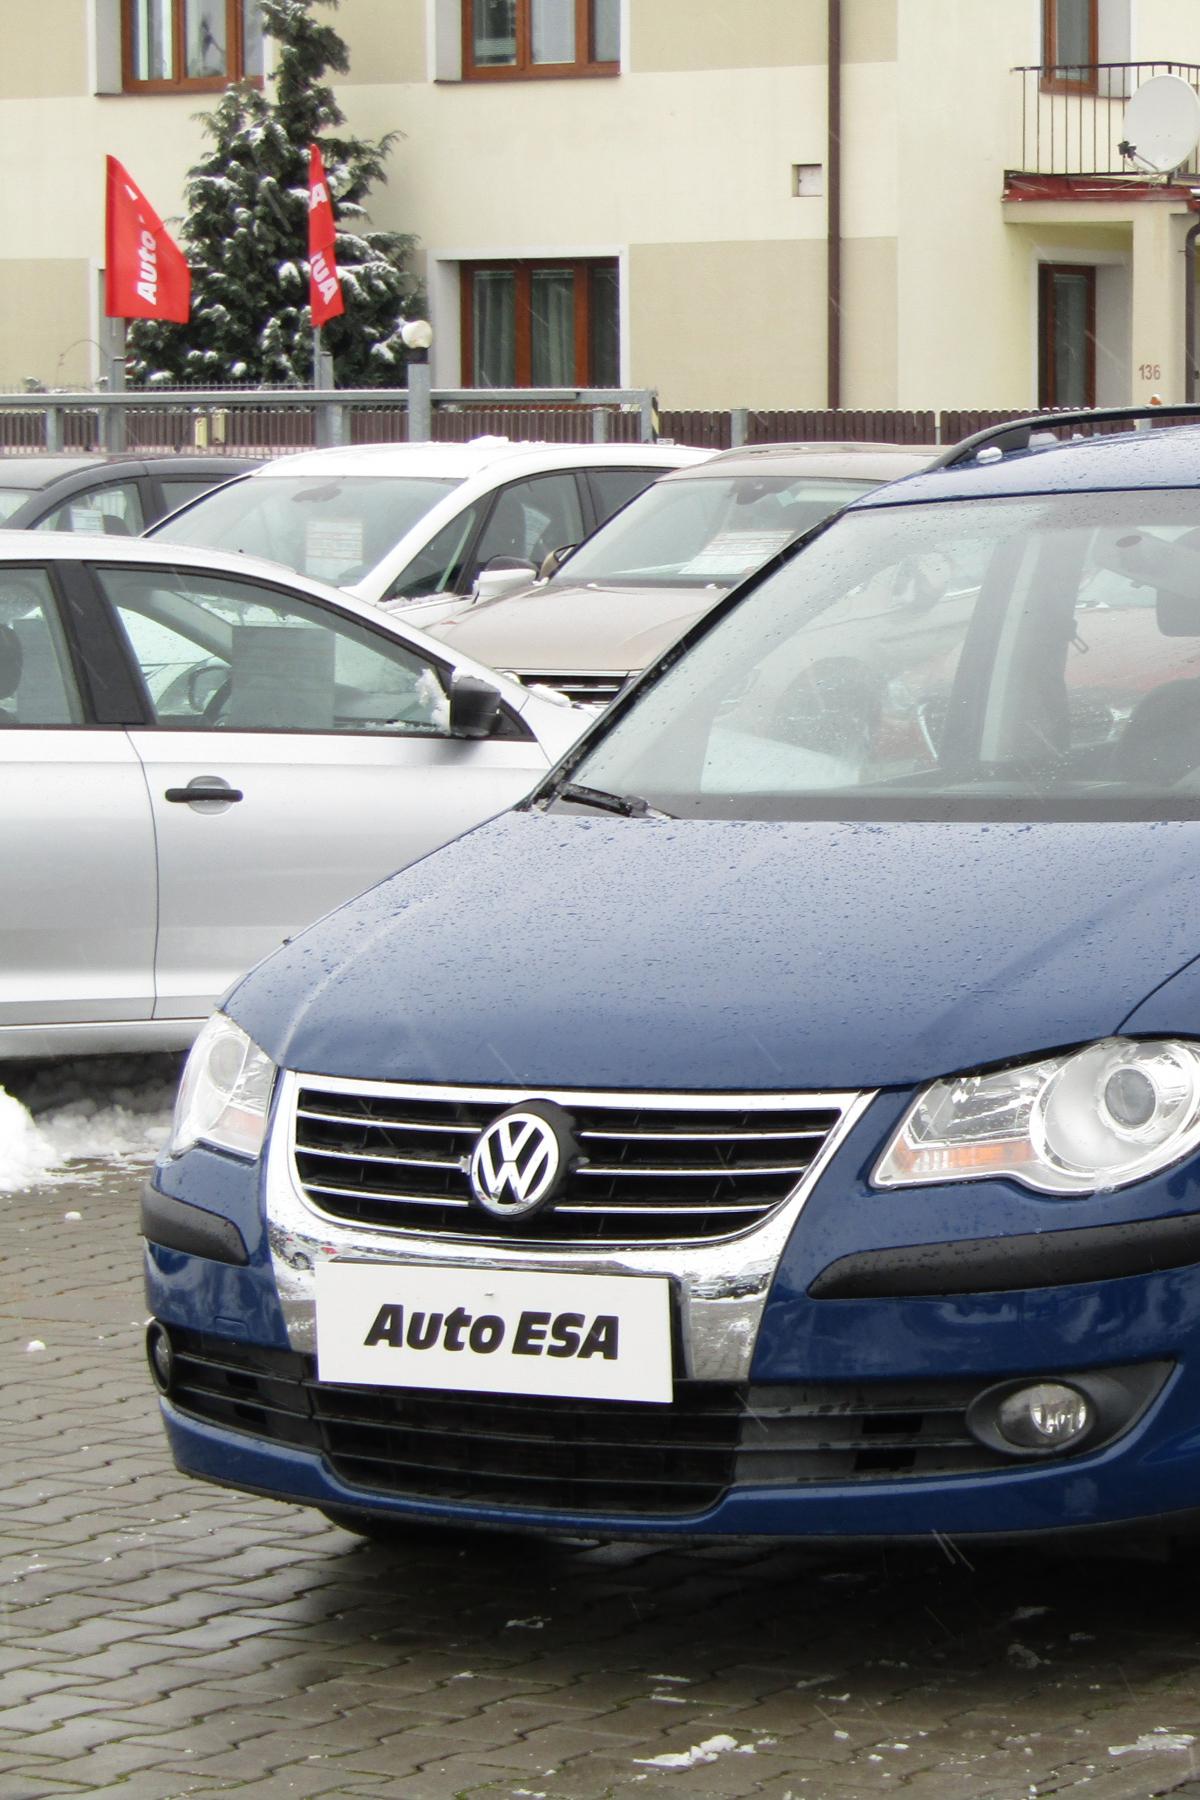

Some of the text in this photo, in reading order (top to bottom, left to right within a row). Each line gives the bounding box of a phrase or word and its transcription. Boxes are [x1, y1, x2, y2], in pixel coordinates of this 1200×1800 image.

[136, 230, 157, 305] Auto
[1139, 364, 1161, 380] 136
[363, 1303, 619, 1360] Auto ESA
